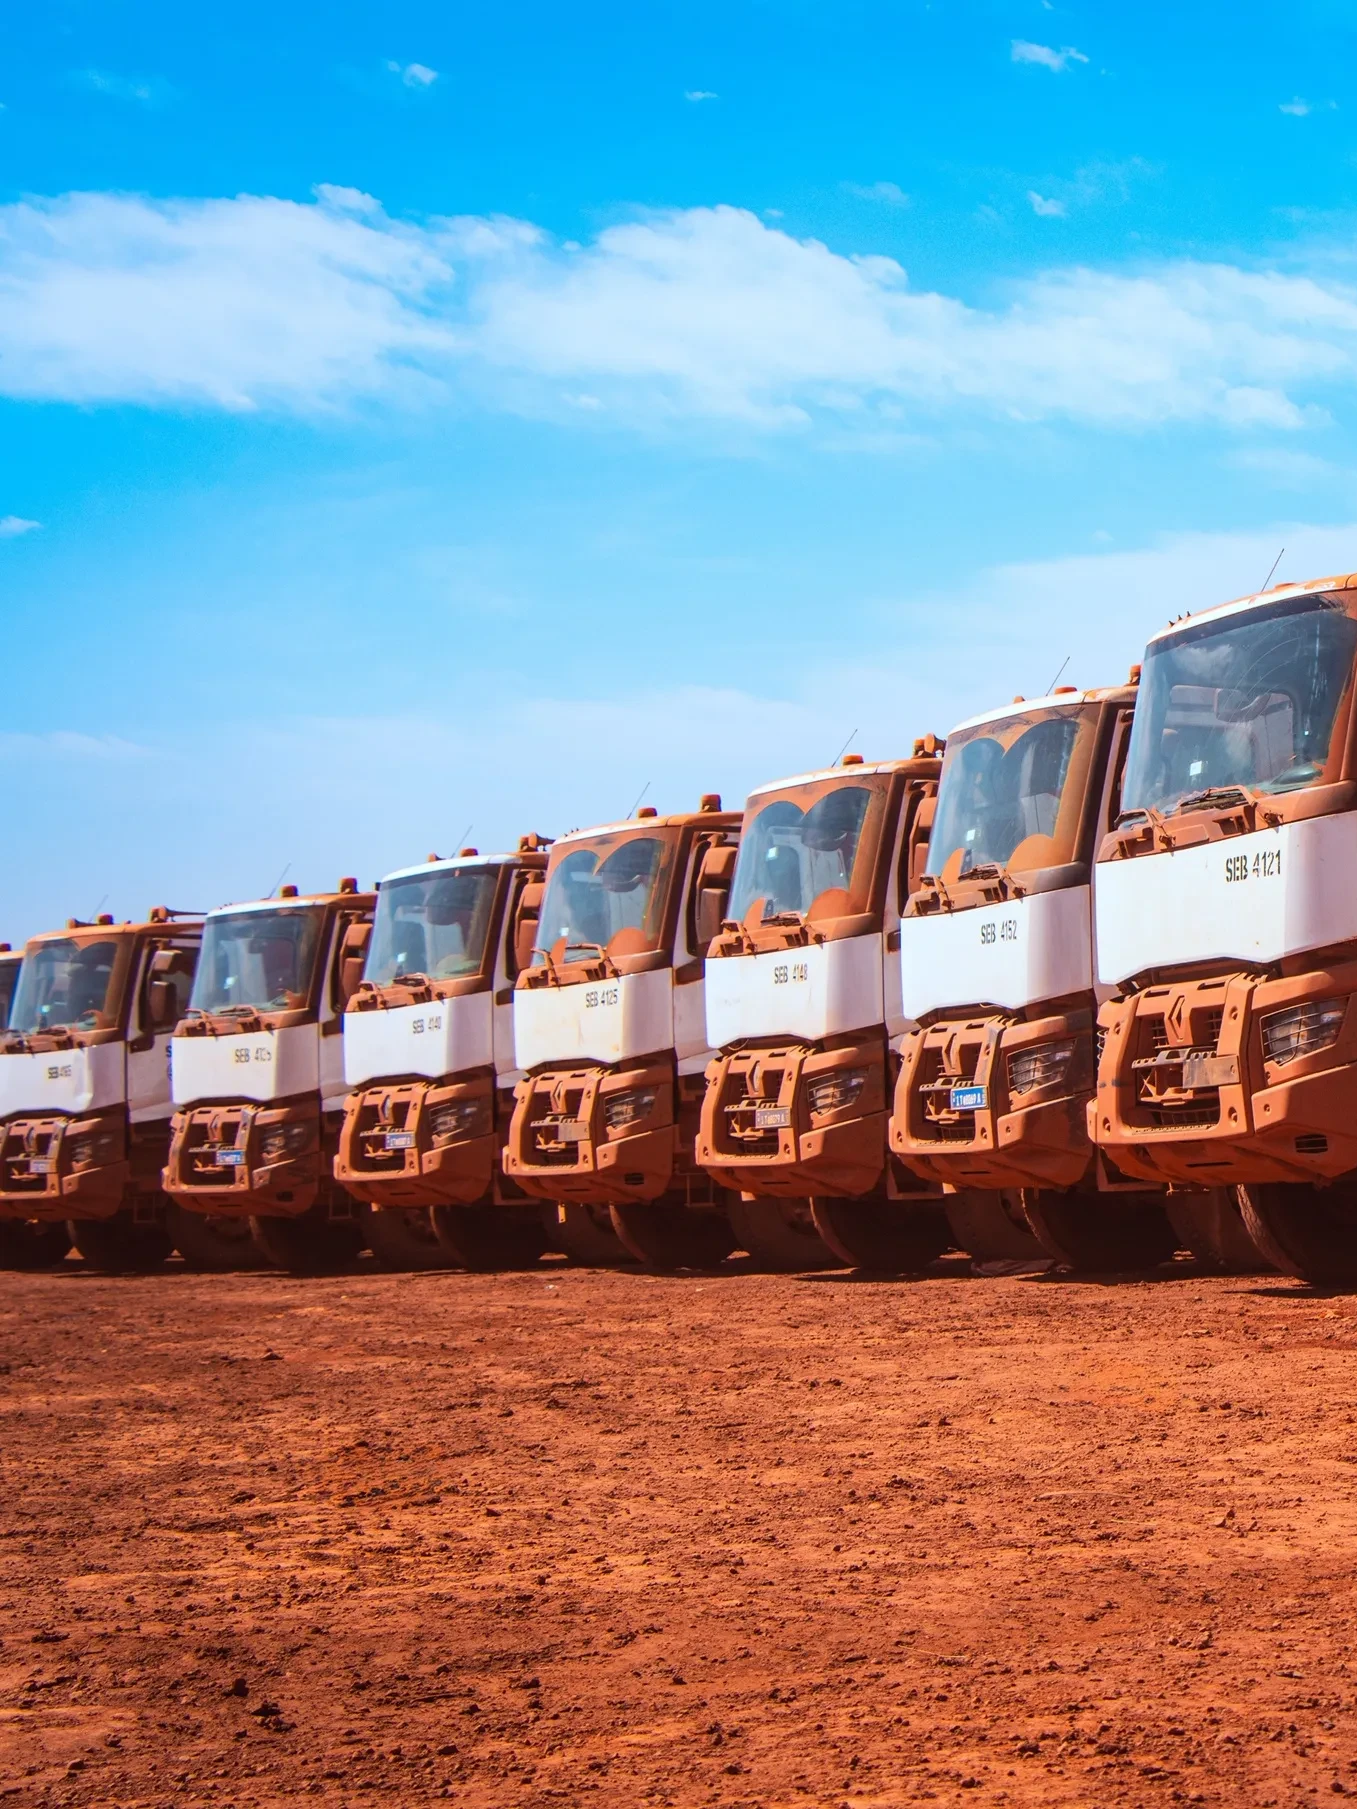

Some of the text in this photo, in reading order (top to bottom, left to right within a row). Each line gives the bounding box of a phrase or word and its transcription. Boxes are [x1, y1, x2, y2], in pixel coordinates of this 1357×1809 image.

[1226, 849, 1281, 883] SEB 4121
[980, 919, 1018, 945] SEB 4152
